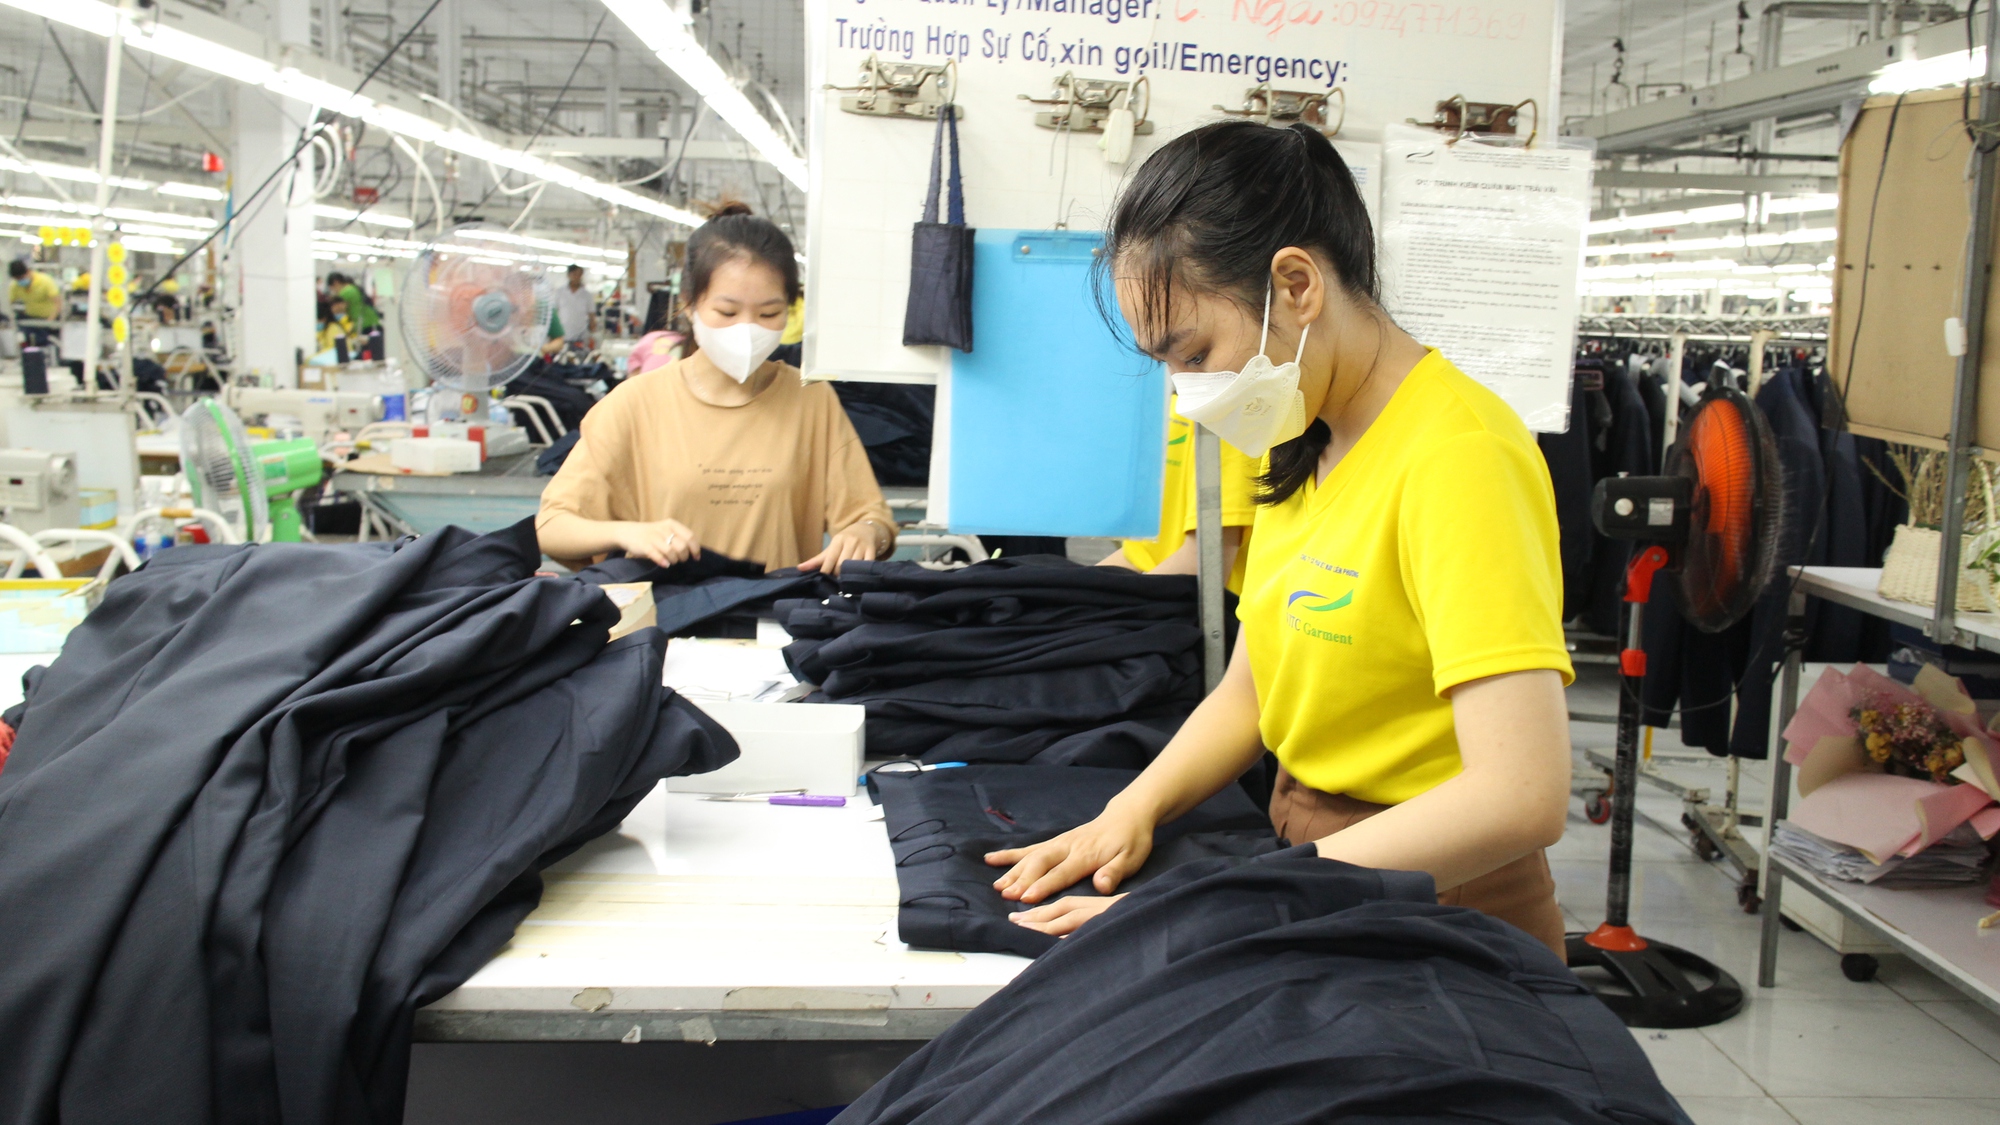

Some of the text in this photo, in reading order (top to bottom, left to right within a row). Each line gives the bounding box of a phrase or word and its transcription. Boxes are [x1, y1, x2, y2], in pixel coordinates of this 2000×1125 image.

[836, 17, 914, 59] Trường
[926, 25, 970, 63] Hợp
[982, 28, 1012, 64] Sự
[1303, 622, 1353, 645] Garment
